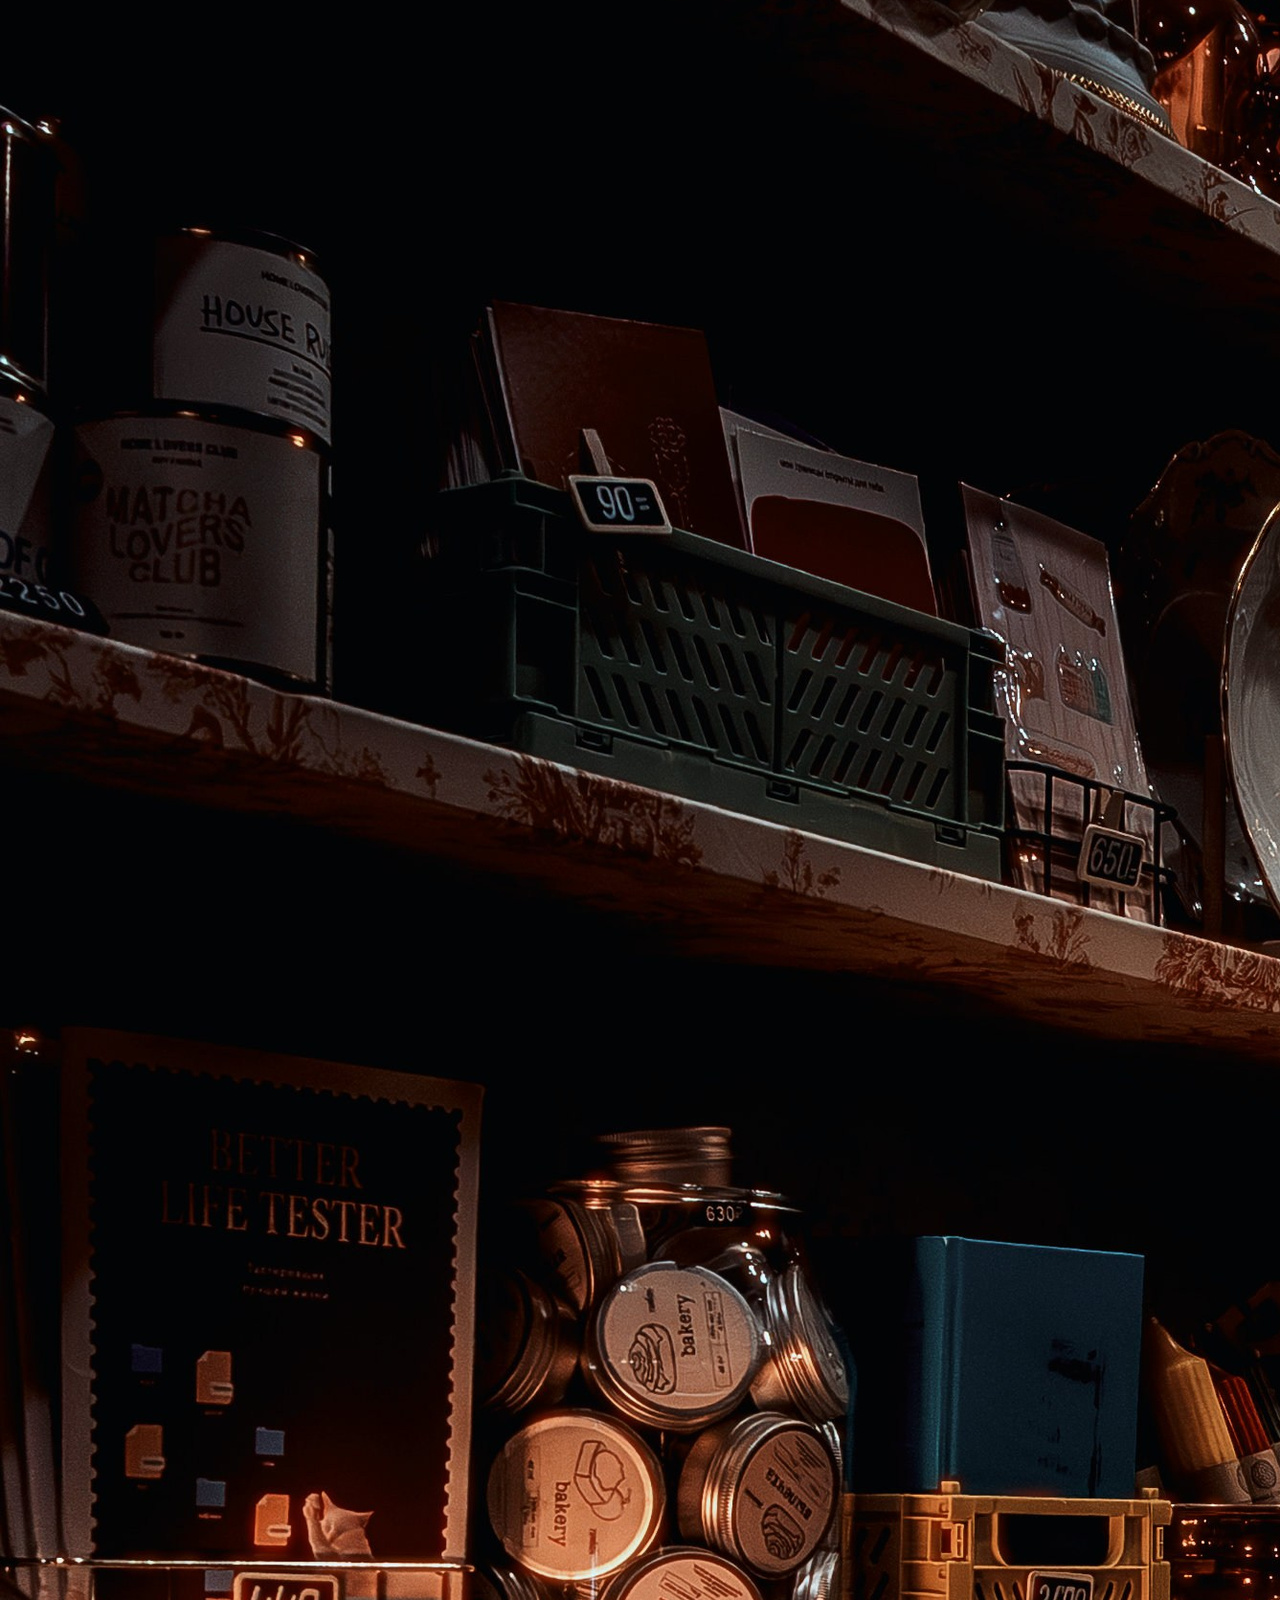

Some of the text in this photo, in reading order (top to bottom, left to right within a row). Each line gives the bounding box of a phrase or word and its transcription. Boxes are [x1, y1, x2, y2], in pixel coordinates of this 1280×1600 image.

[201, 295, 296, 344] HOUSE
[106, 485, 251, 527] MATCHA
[110, 513, 245, 560] LOVERS
[129, 548, 221, 588] CLUB
[208, 1126, 365, 1191] BETTER
[160, 1179, 407, 1250] LIFE TESTER
[677, 1293, 697, 1358] bakery
[547, 1480, 571, 1548] bakery
[766, 1466, 814, 1521] выпечка
